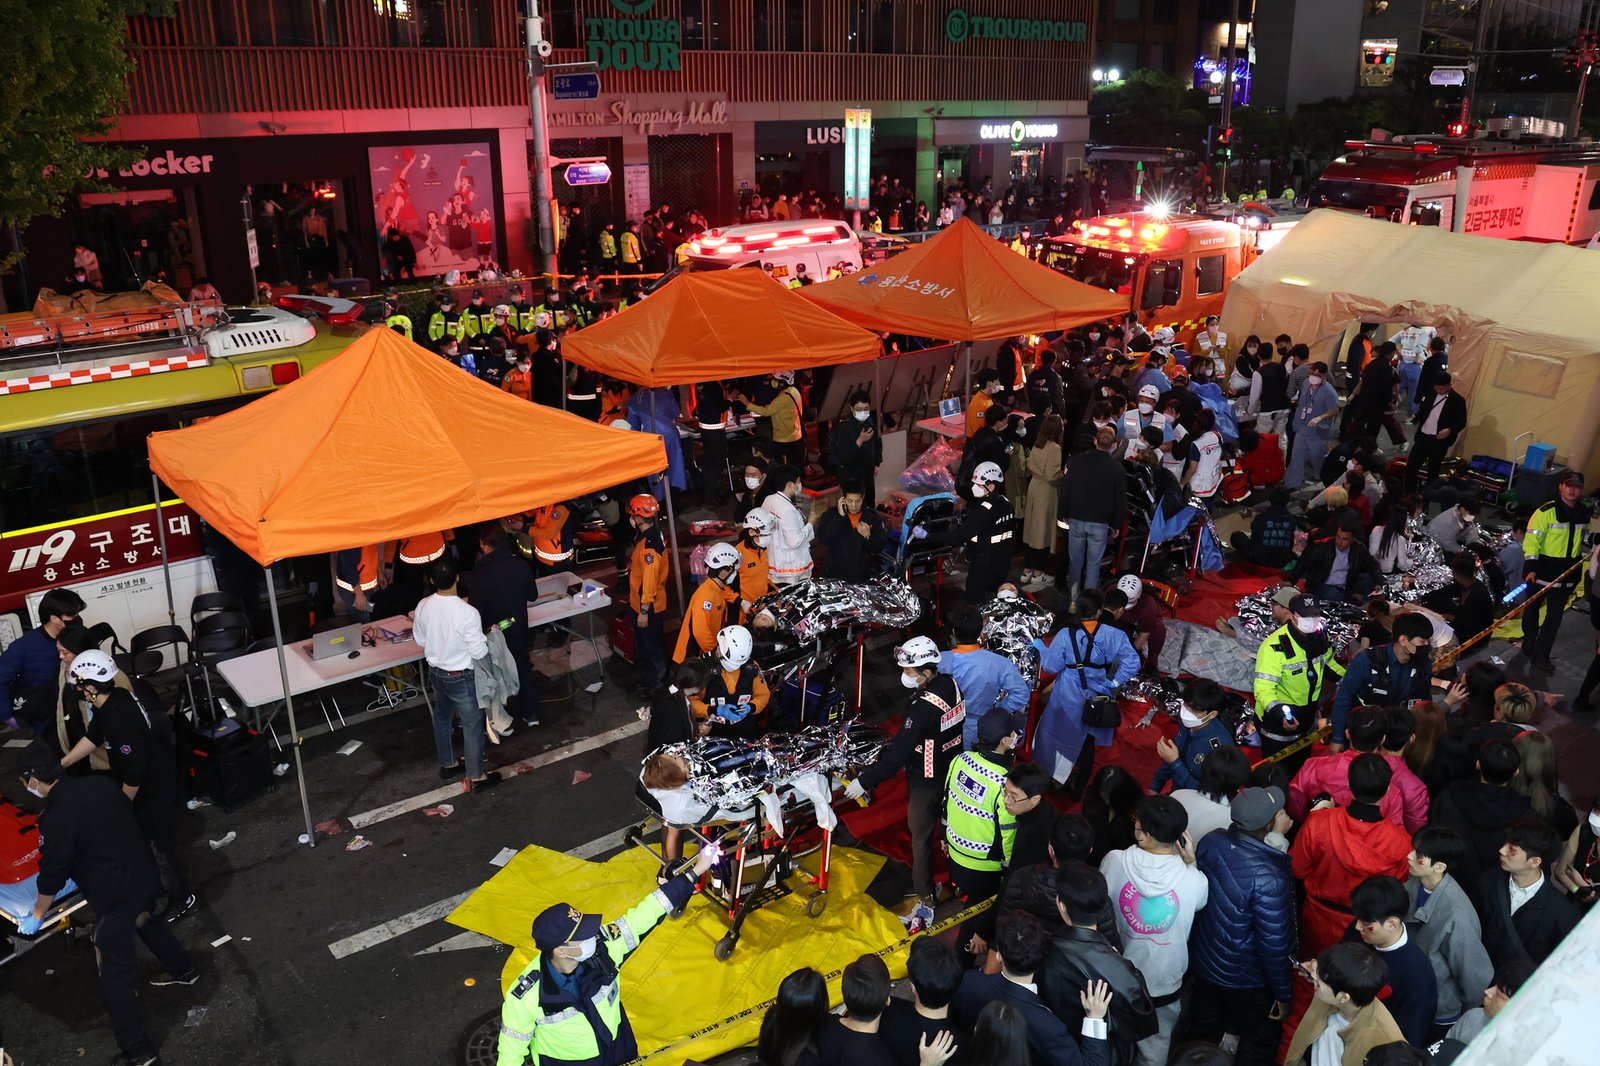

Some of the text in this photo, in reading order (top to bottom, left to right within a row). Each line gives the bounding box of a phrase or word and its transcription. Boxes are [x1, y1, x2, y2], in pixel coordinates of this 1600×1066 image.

[586, 16, 680, 42] TROUBA
[970, 16, 1087, 42] TROUBADOUR
[586, 41, 681, 71] DOUR
[547, 99, 727, 135] AMILTON Shopping Mall
[980, 124, 1058, 139] OLIVE YOUNG
[878, 275, 956, 299] 용산소방서
[7, 529, 76, 573] 119
[956, 781, 979, 801] POLICE
